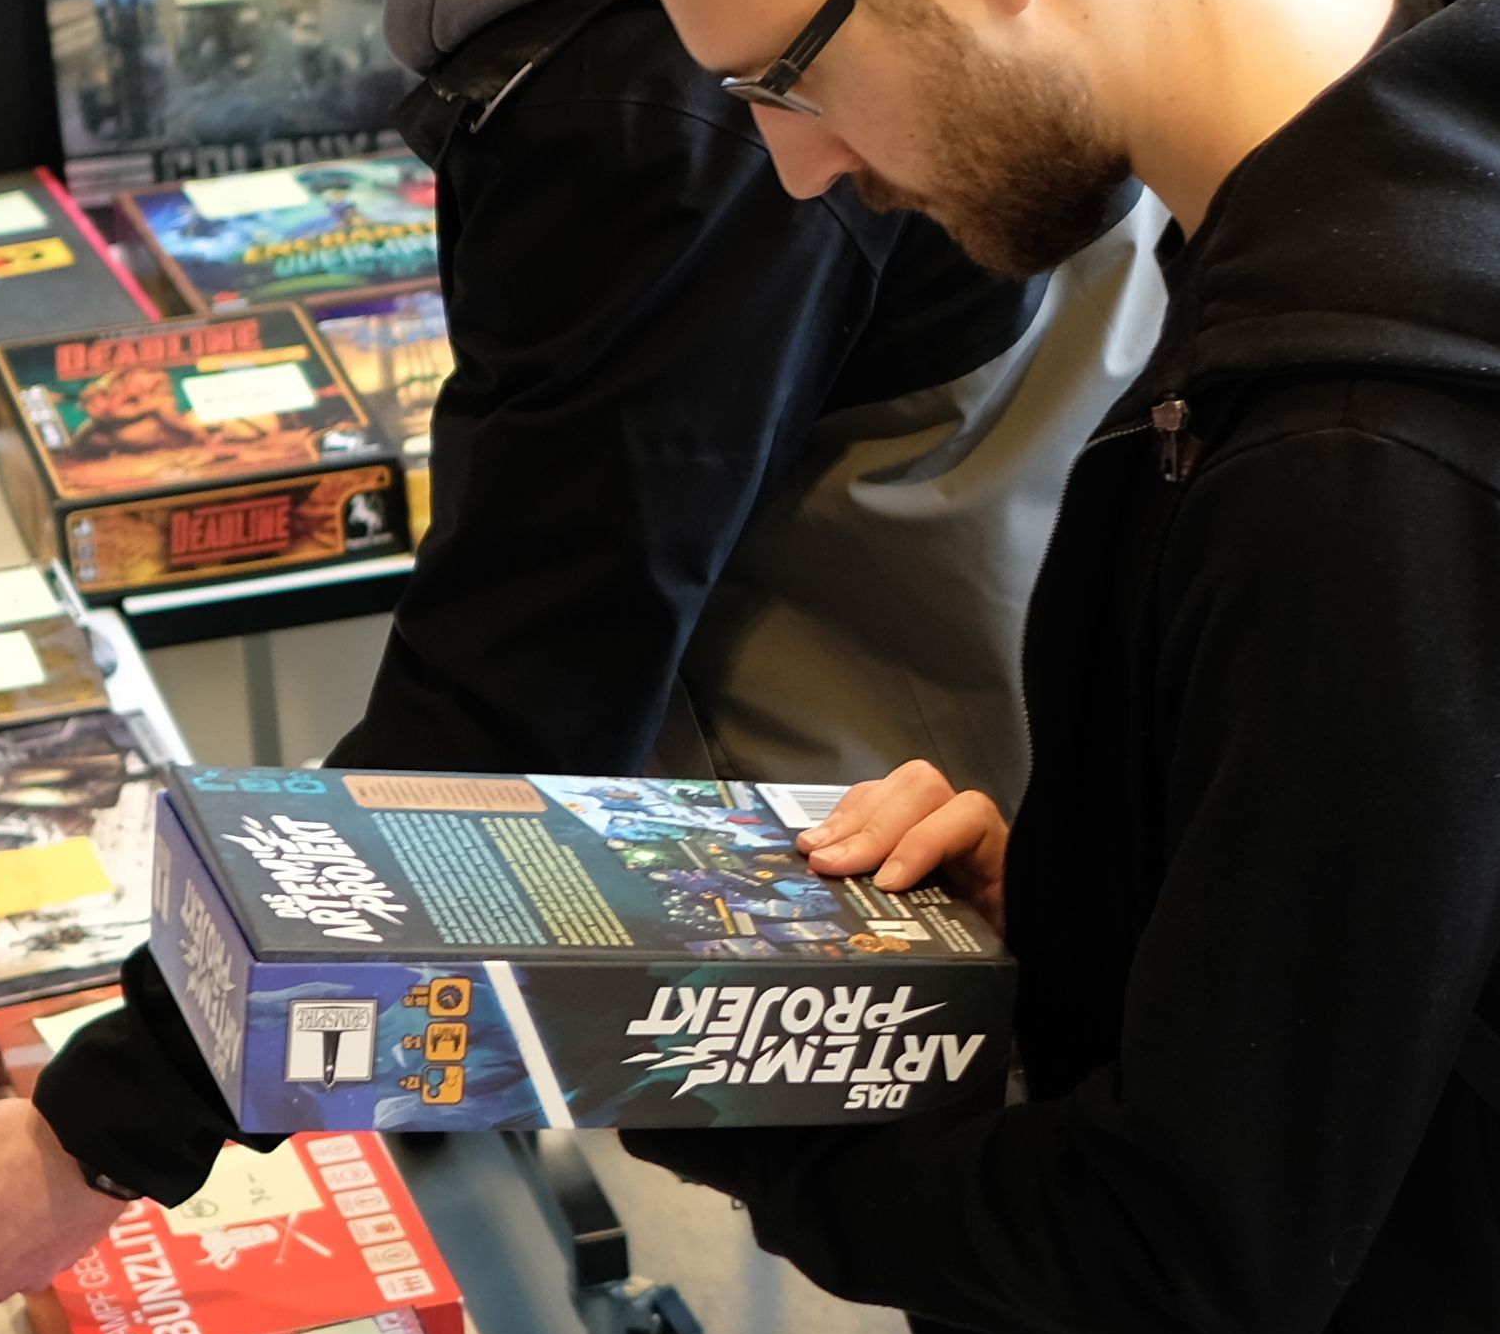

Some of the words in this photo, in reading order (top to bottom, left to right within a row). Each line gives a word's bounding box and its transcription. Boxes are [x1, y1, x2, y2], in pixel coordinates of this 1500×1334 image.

[55, 318, 262, 380] DEADLINE
[169, 496, 292, 567] DEADLINE
[220, 813, 384, 945] ARTEMIS
[270, 813, 410, 926] PROJEKT
[261, 892, 308, 921] DAS
[295, 1007, 372, 1030] GRIMSPIRE
[624, 985, 949, 1060] PROJEKT
[621, 1034, 987, 1100] ARTEMIS
[844, 1082, 913, 1109] DAS
